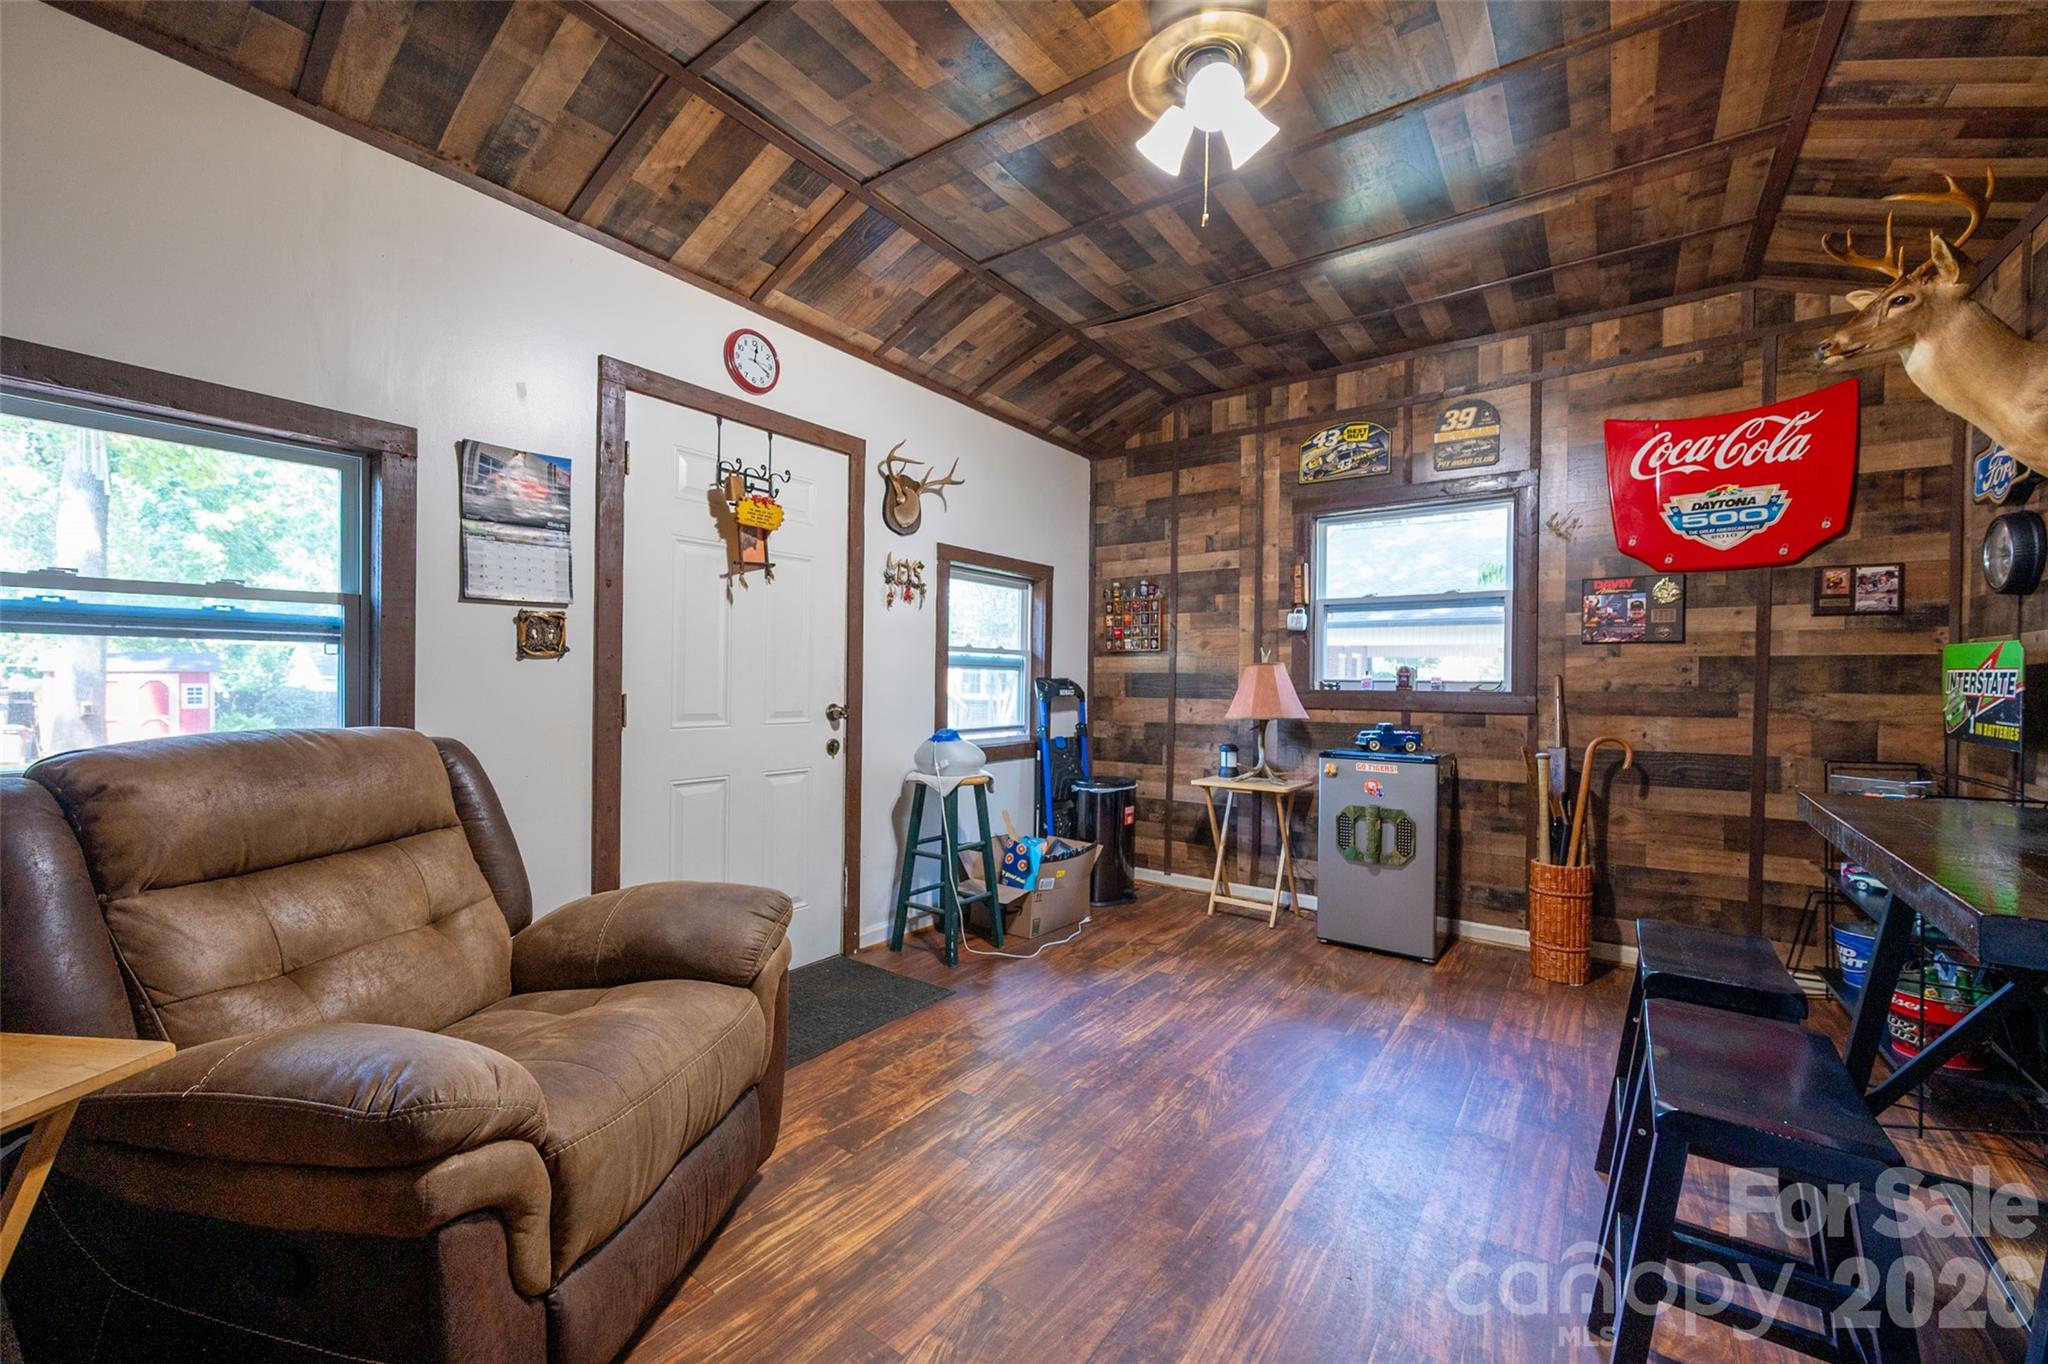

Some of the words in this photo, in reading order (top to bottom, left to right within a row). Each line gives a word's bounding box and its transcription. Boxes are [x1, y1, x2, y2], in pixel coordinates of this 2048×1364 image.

[1440, 406, 1478, 431] 39
[1313, 429, 1341, 448] 43
[1630, 409, 1823, 481] Coca-Cola
[1691, 496, 1757, 511] DAYTONA
[1682, 507, 1769, 528] 500
[1593, 578, 1635, 590] DAVEY
[1947, 671, 2017, 695] INTERSTATE
[1983, 723, 2020, 741] BATTERIES
